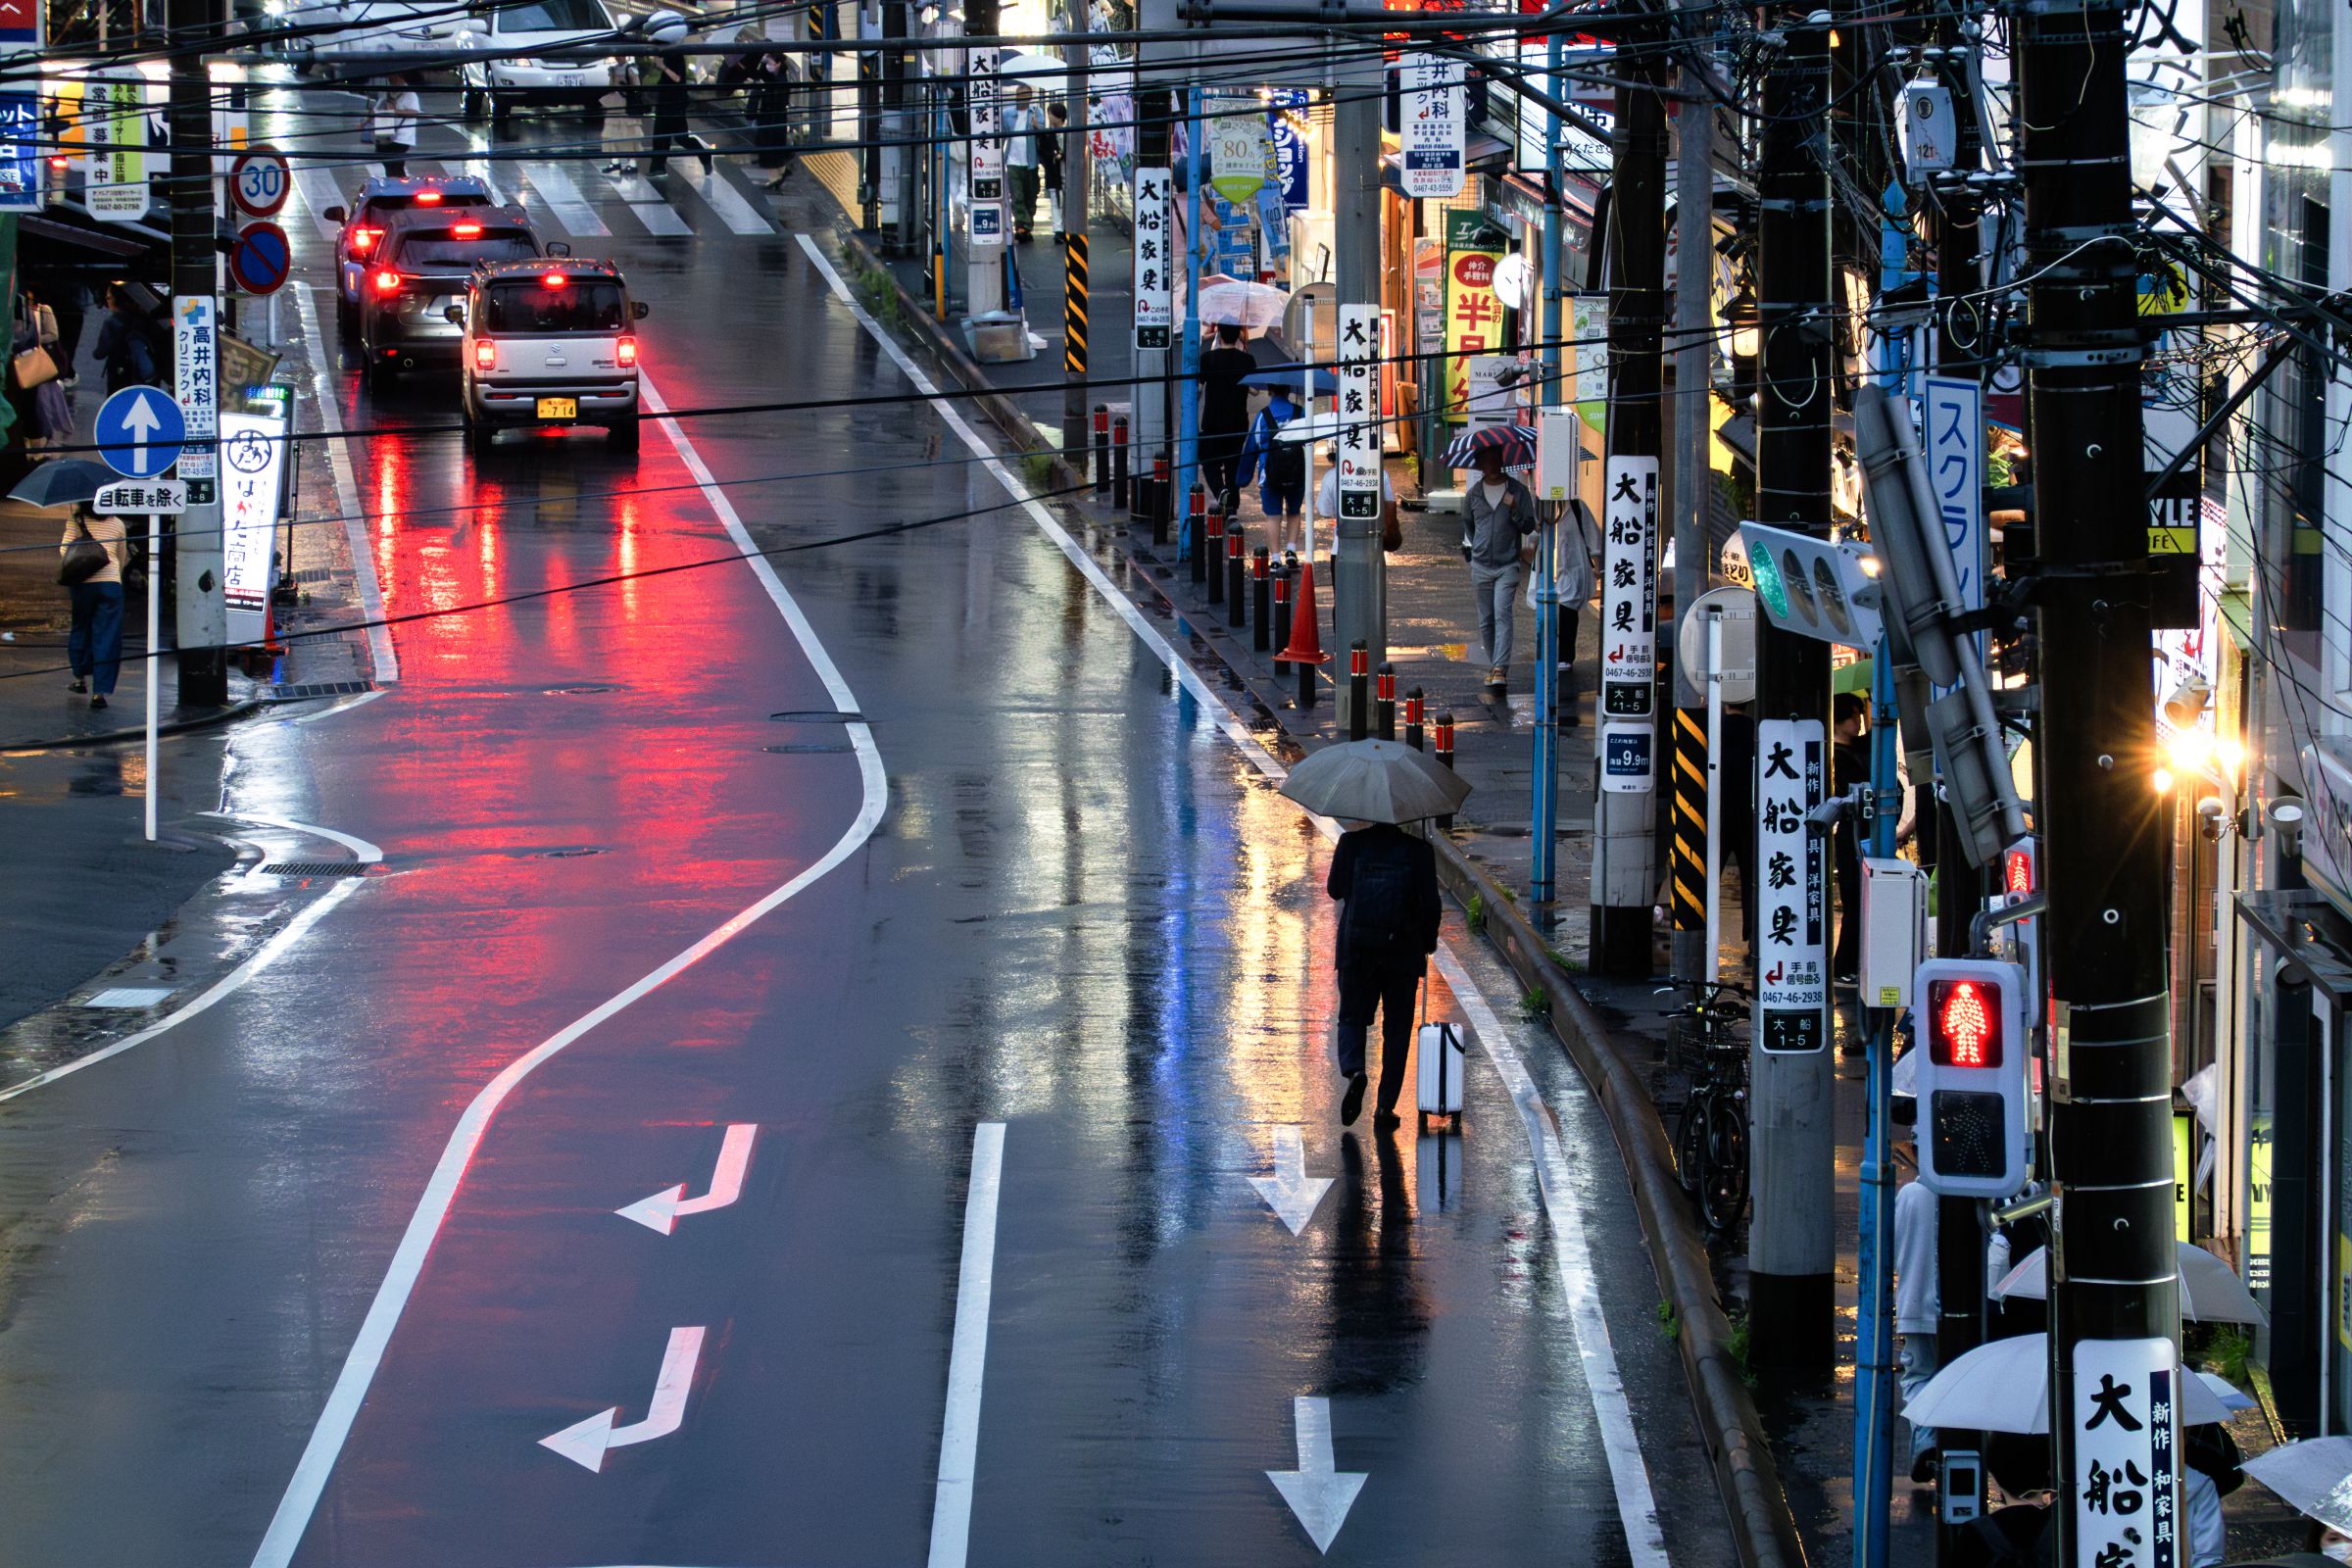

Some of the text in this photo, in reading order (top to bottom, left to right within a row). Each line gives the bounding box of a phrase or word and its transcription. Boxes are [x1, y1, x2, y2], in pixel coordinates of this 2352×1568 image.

[1224, 140, 1248, 158] 80
[245, 165, 279, 198] 30
[1138, 179, 1161, 291] 大船家具
[179, 331, 191, 391] クリニック
[193, 326, 212, 407] 高井内科
[1343, 318, 1367, 450] 大船家具
[100, 488, 182, 508] 自転車を除く
[1646, 489, 1655, 514] 新作
[1350, 506, 1368, 514] 1-5
[1609, 472, 1643, 633] 大船家具
[1605, 667, 1652, 678] 0467-46-2938
[1614, 689, 1644, 700] 大船
[1618, 701, 1641, 711] 1-5
[1807, 761, 1820, 792] 新作
[1763, 742, 1805, 946] 大船家具
[1790, 961, 1817, 973] 手前
[1786, 973, 1821, 986] 信号曲る
[1762, 991, 1824, 1004] 0467-46-2938
[1773, 1019, 1812, 1031] 大船
[1779, 1035, 1806, 1046] 1-5
[2153, 1402, 2170, 1450] 新作
